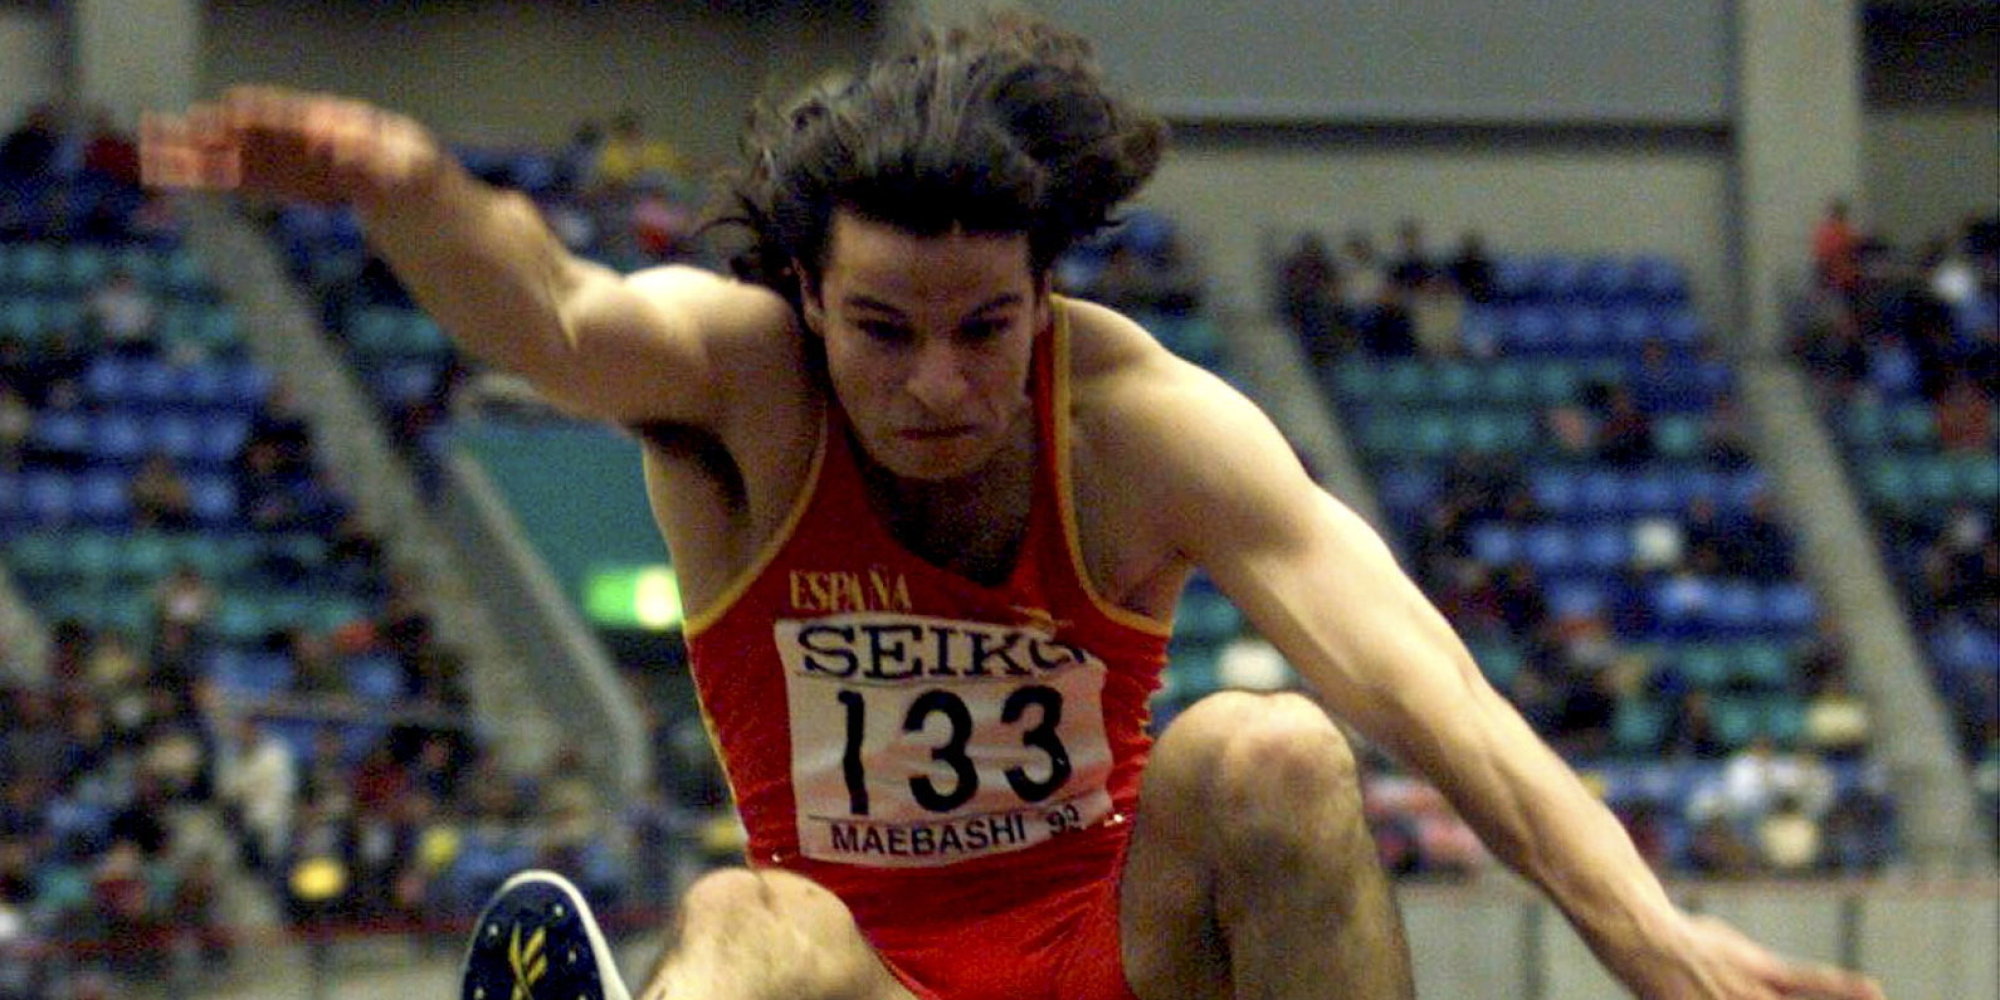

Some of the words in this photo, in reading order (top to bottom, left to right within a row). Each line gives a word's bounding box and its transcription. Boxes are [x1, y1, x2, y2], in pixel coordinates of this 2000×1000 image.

[789, 564, 913, 611] ESPAÑA
[837, 685, 1071, 816] 133
[831, 813, 1025, 856] MAEBASHI
